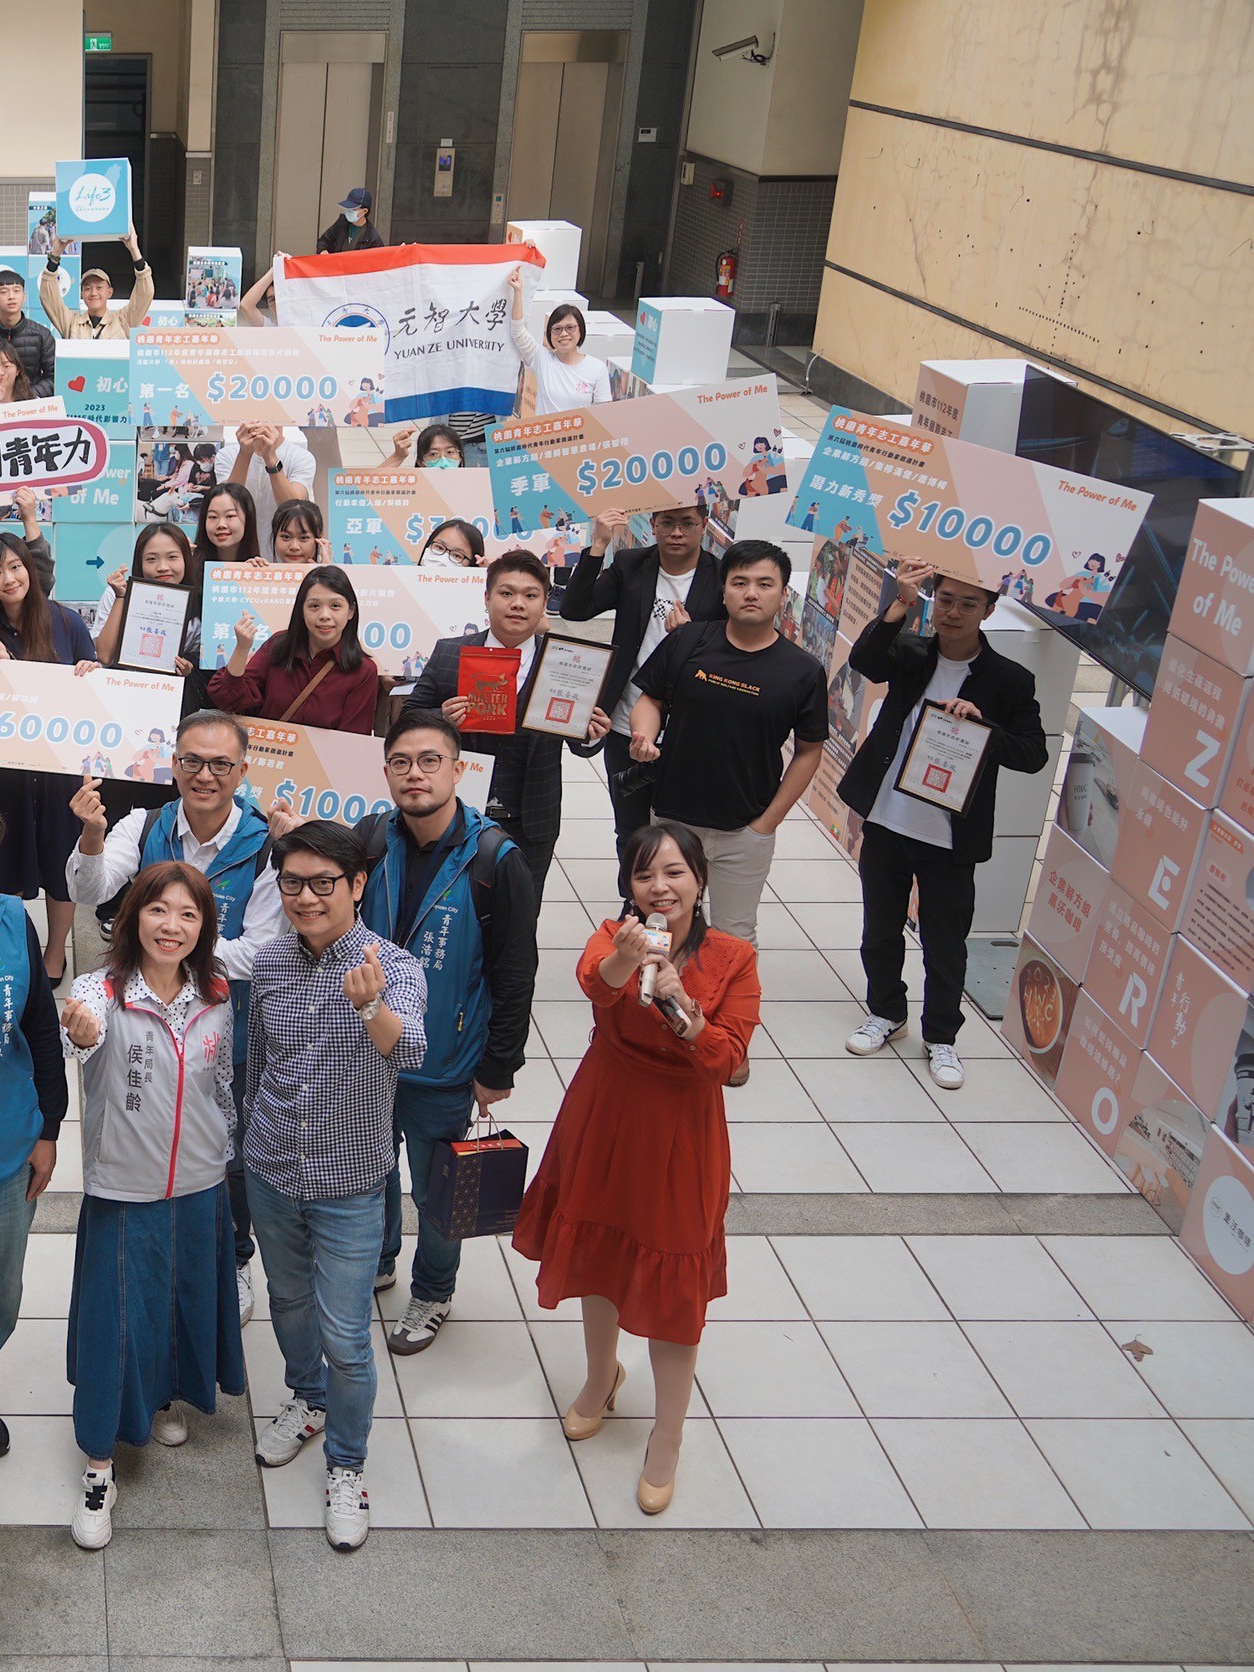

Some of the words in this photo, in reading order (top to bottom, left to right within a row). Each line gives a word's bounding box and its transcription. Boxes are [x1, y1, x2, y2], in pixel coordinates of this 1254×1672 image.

[158, 315, 178, 327] 初心
[393, 299, 507, 338] 元智大學
[137, 334, 218, 345] 桃園青年志工嘉年華
[319, 335, 332, 343] The
[333, 335, 355, 344] Power
[366, 335, 378, 343] Me
[394, 345, 425, 360] YUAN
[428, 342, 443, 354] ZE
[447, 338, 505, 352] UNIVERSITY
[97, 376, 129, 393] 初心
[139, 382, 190, 399] 第一名
[207, 372, 338, 404] $20000
[698, 394, 713, 404] The
[716, 390, 741, 402] Power
[743, 388, 752, 397] of
[754, 385, 768, 395] Me
[2, 409, 16, 419] The
[16, 406, 39, 417] Power
[47, 404, 59, 413] Me
[493, 417, 583, 441] 桃園青年志工嘉年華
[834, 418, 933, 452] 桃園青年志工嘉年華
[335, 475, 417, 485] 桃園青年志工嘉年華
[577, 442, 727, 497] $20000
[511, 473, 551, 496] 季軍
[809, 474, 884, 508] 潛力新秀獎
[70, 489, 89, 504] of
[93, 489, 120, 505] Me
[1058, 480, 1075, 492] The
[1077, 485, 1107, 503] Power
[1108, 495, 1121, 506] of
[1121, 498, 1137, 512] Me
[346, 517, 383, 535] 亞軍
[888, 488, 1053, 568] $10000
[212, 570, 305, 581] 桃園青年志工嘉年華
[1193, 537, 1214, 572] The
[1220, 555, 1254, 594] Powe
[417, 574, 433, 583] The
[434, 574, 459, 584] Power
[461, 575, 469, 584] of
[471, 576, 484, 584] Me
[1193, 593, 1213, 617] of
[1213, 603, 1243, 637] Me
[212, 622, 270, 641] 第名
[106, 677, 121, 687] The
[124, 678, 150, 690] Power
[151, 680, 161, 690] of
[161, 683, 175, 692] Me
[709, 673, 724, 682] KING
[724, 678, 741, 687] KONG
[740, 682, 761, 692] BLACK
[466, 702, 508, 716] PORK
[467, 693, 508, 704] MASTER
[247, 727, 297, 743] 志工嘉年華
[470, 763, 484, 773] Me
[1184, 729, 1221, 788] Z
[1048, 870, 1092, 919] 企業解方組
[217, 902, 230, 937] 青年事
[1047, 893, 1084, 934] 黑沃咖啡
[433, 914, 452, 971] 青年事務局
[4, 974, 14, 982] City
[1118, 971, 1147, 1028] R
[2, 984, 14, 1046] 青年事務局
[143, 1031, 154, 1083] 青年局長
[126, 1044, 143, 1113] 侯佳齡
[1223, 1211, 1253, 1249] 黑沃咖啡
